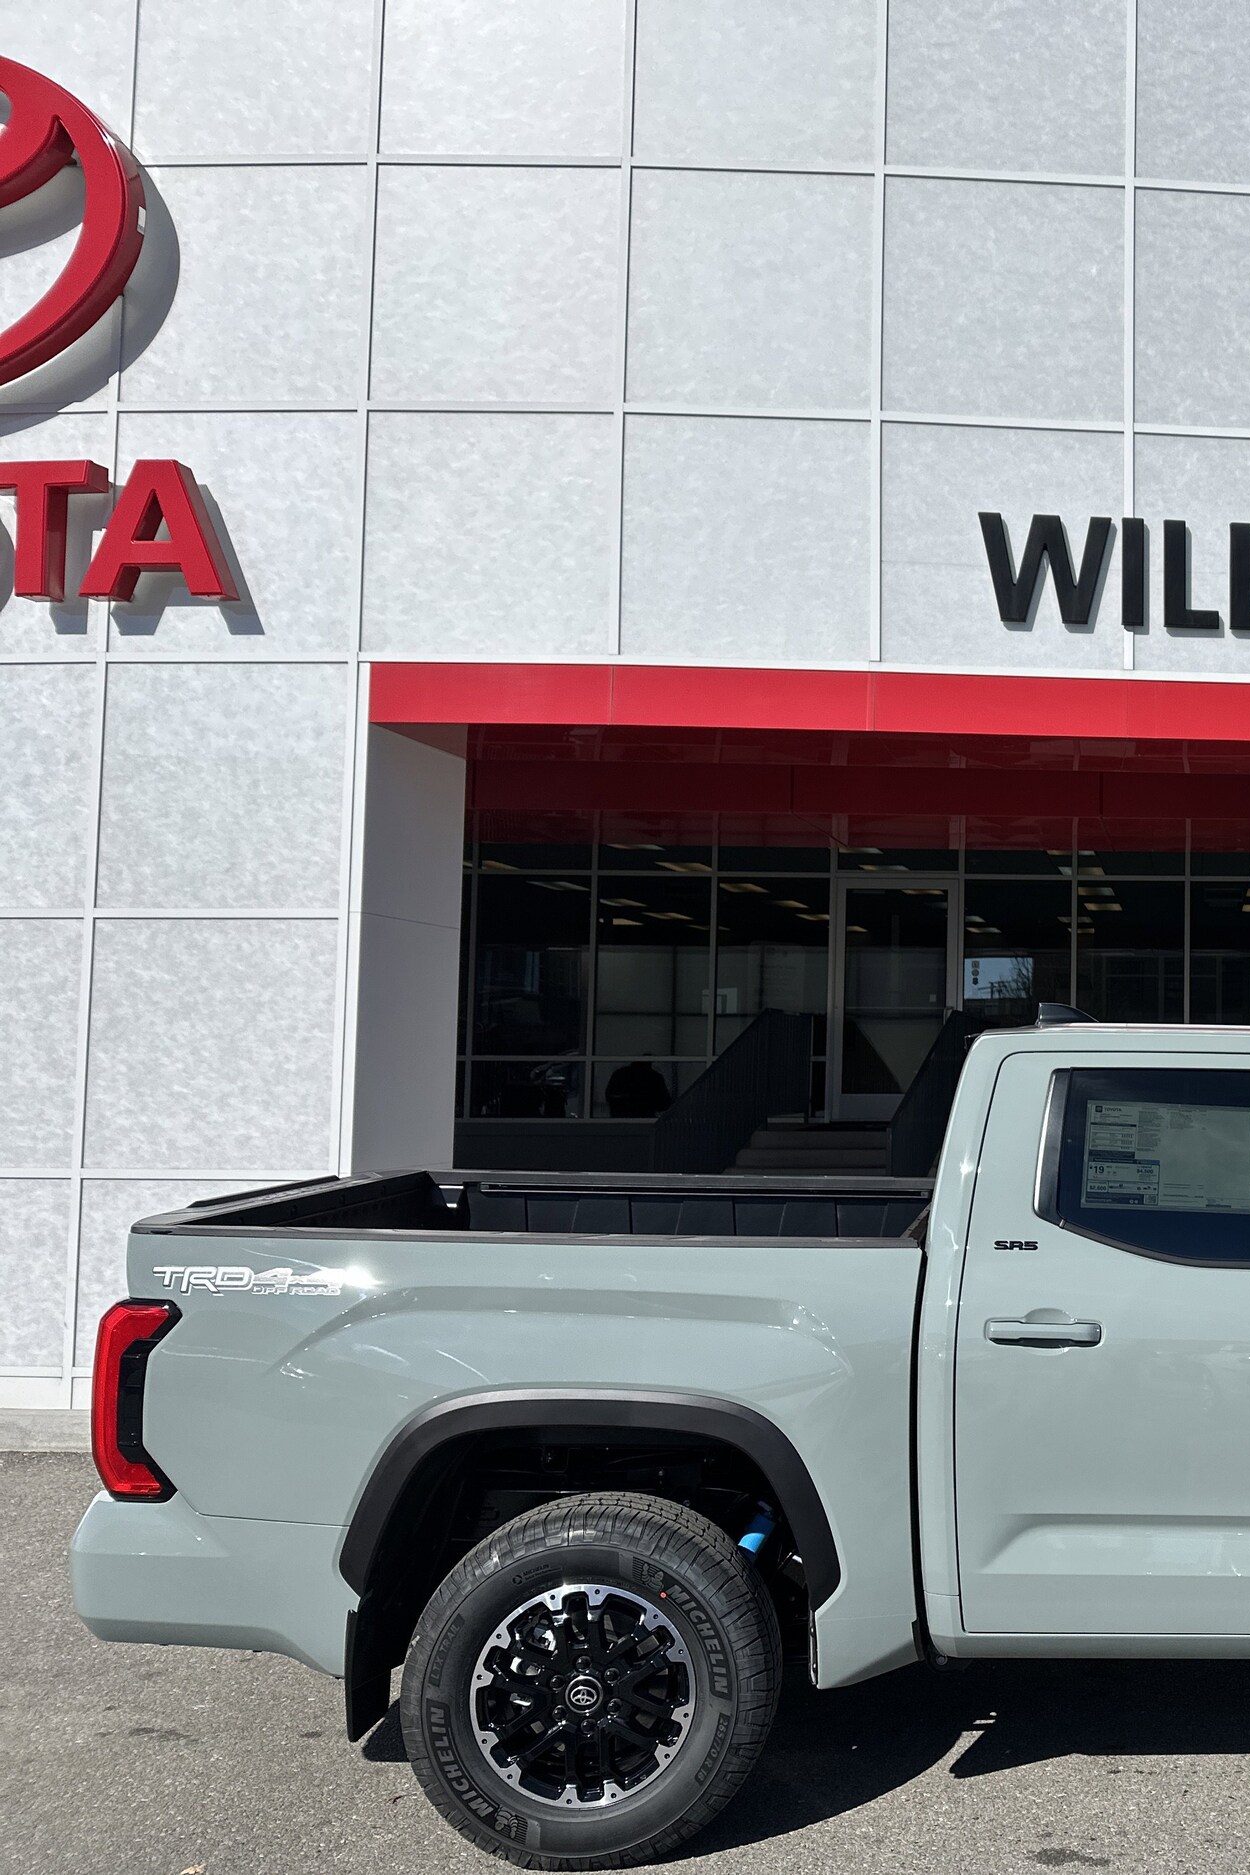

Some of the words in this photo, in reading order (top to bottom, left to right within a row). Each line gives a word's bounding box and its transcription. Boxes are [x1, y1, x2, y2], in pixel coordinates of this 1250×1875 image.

[1094, 1165, 1105, 1174] 19
[994, 1240, 1038, 1251] SR5
[152, 1266, 254, 1297] TRD
[430, 1656, 445, 1680] LTX
[439, 1623, 462, 1653] TRAIL
[665, 1584, 729, 1694] MICHELIN
[708, 1717, 729, 1759] 265/70
[429, 1705, 495, 1818] MICHELIN
